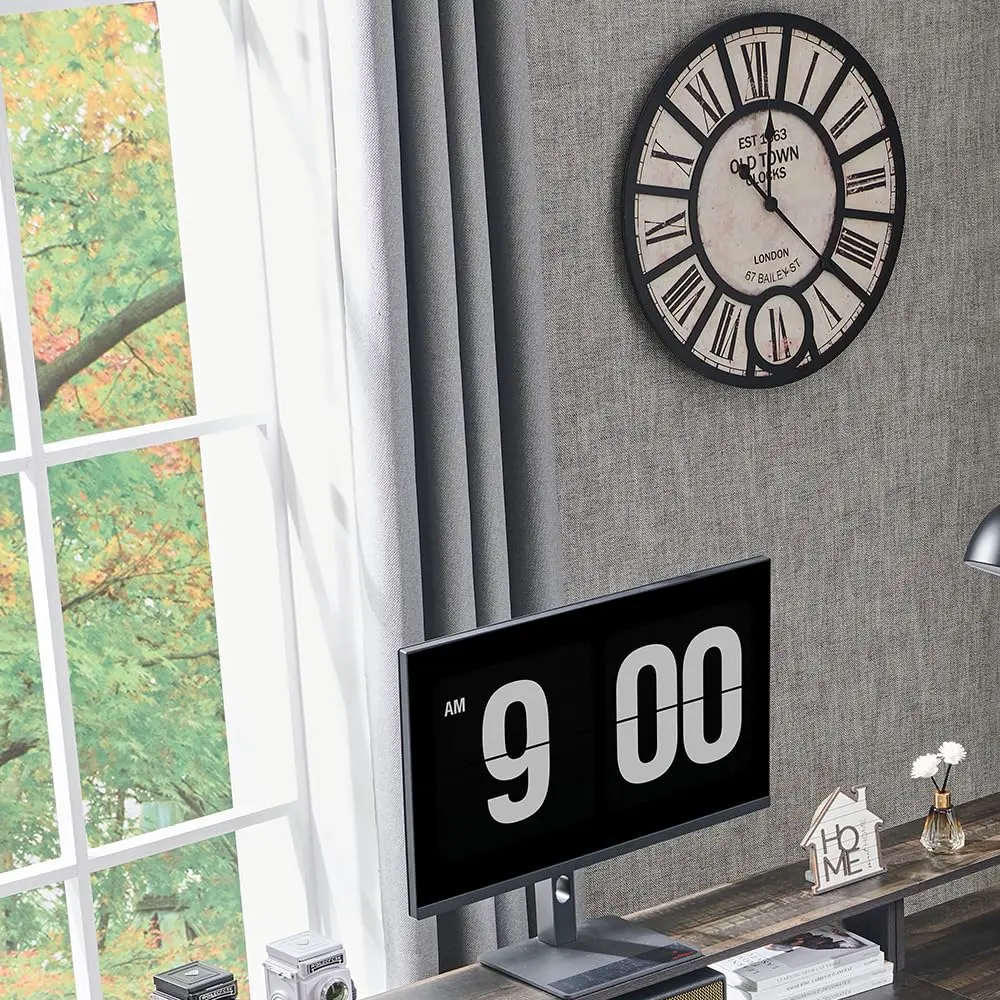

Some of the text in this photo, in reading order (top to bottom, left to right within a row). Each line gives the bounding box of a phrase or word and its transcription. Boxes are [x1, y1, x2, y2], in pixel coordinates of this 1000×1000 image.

[738, 128, 788, 150] EST 163
[758, 145, 800, 168] TOWN
[745, 166, 788, 187] CLOKS
[753, 248, 790, 265] LONDON
[744, 257, 801, 284] 67 BAILEY ST
[443, 625, 743, 824] AM 9 00
